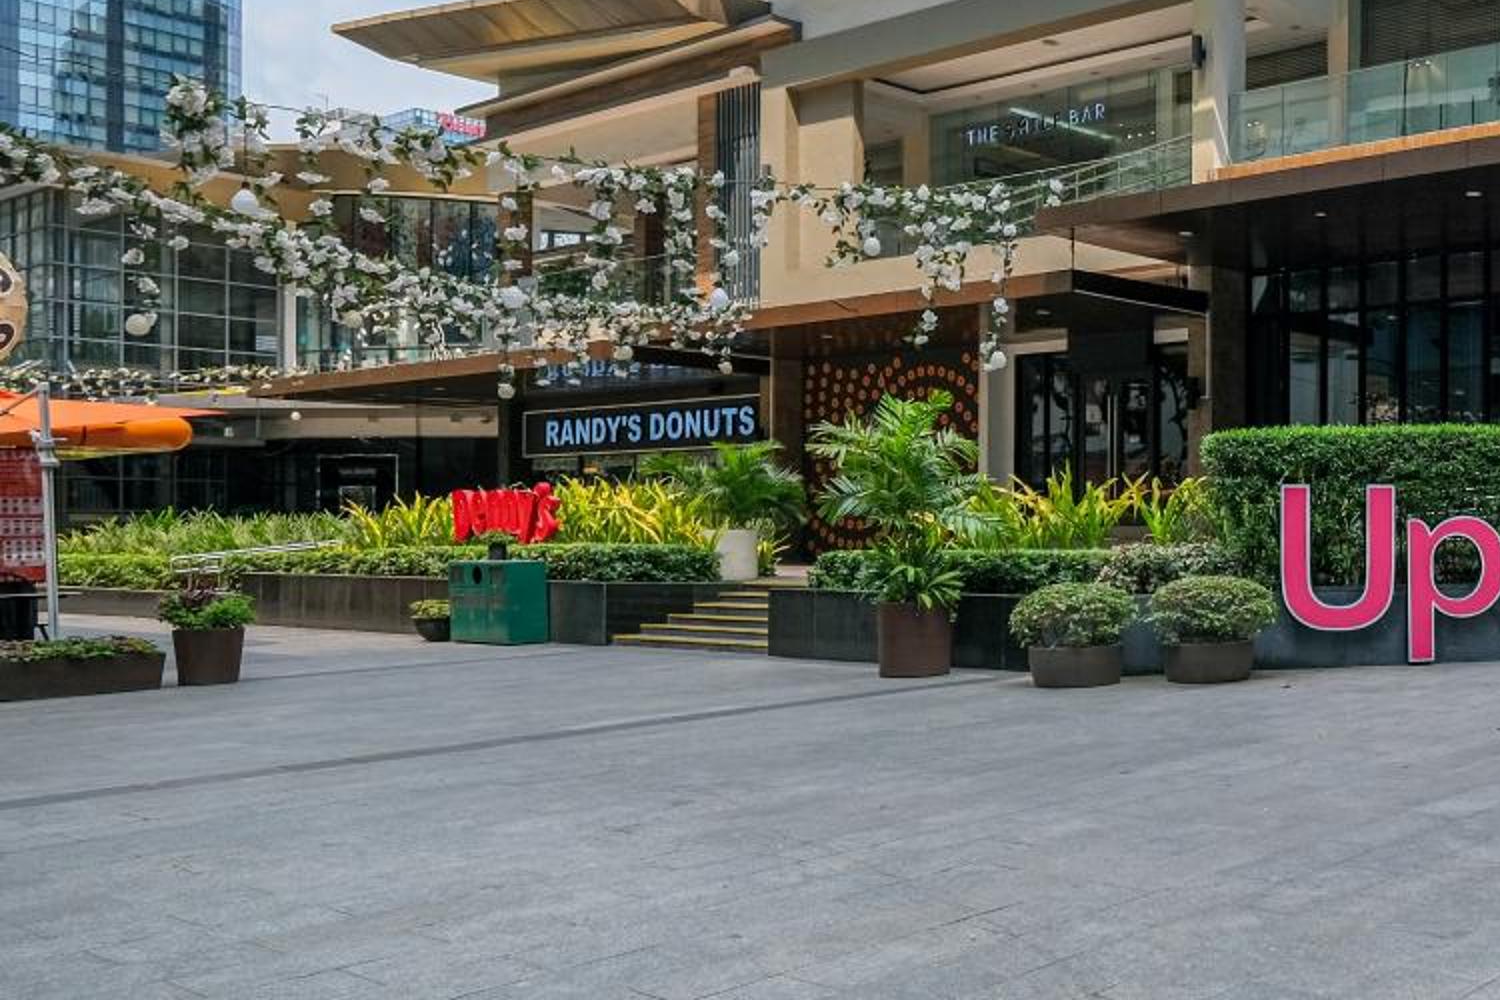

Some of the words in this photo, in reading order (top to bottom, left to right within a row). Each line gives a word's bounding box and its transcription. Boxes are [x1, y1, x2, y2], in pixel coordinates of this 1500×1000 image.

[967, 126, 1000, 146] THE
[1069, 104, 1105, 124] BAR
[545, 414, 641, 447] RANDY'S
[649, 405, 755, 441] DONUTS
